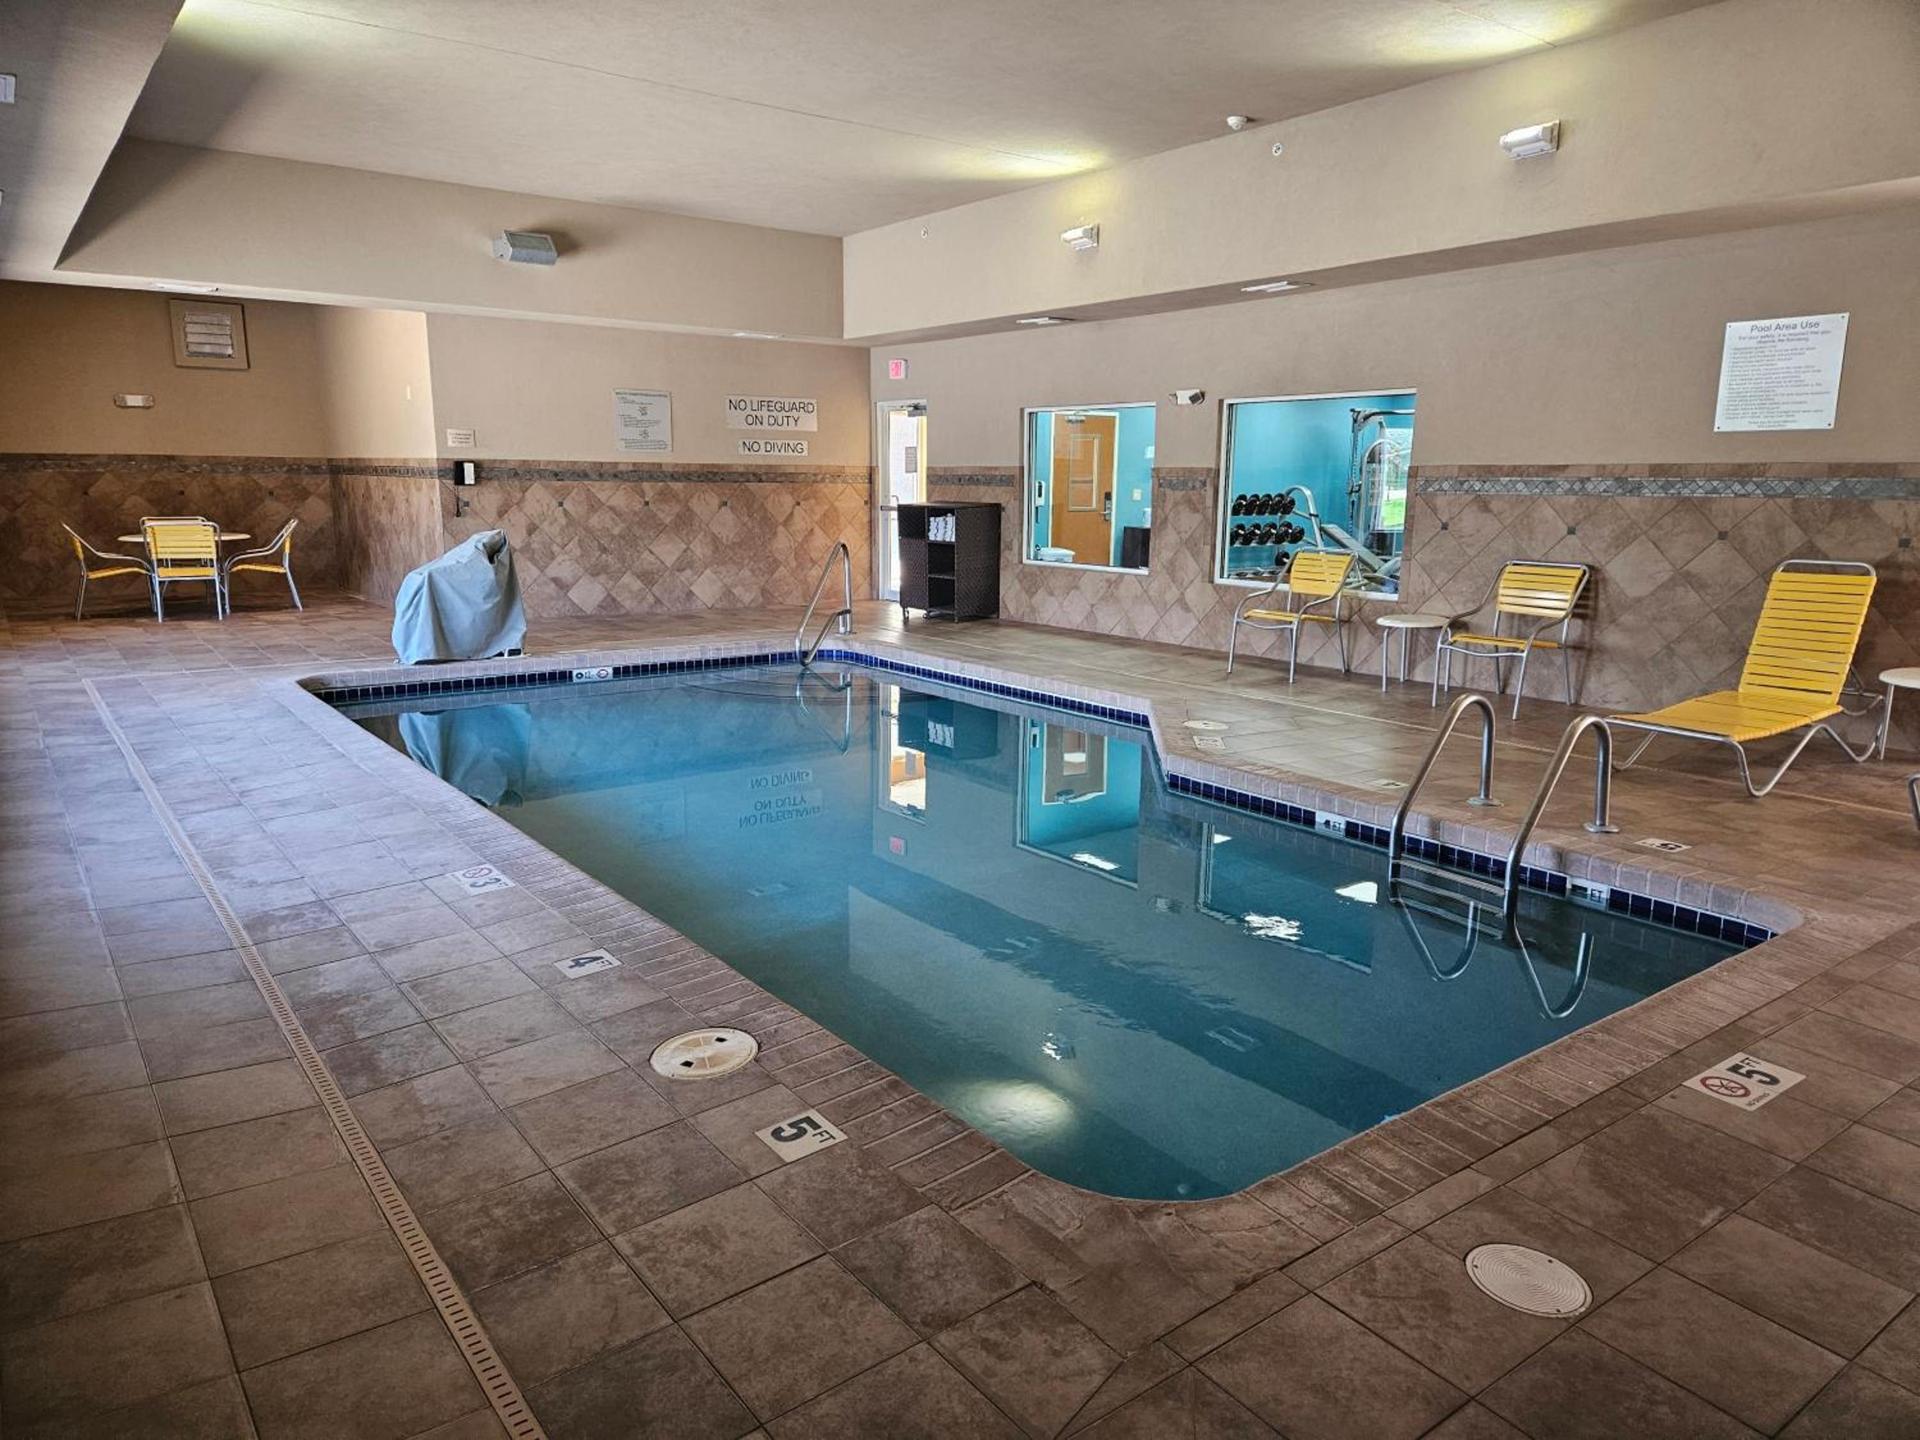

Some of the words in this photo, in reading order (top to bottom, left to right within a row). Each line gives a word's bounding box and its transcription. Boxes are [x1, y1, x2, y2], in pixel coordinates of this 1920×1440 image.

[1750, 324, 1772, 333] Pool
[1774, 322, 1797, 331] Area
[1800, 320, 1820, 329] Use
[728, 399, 747, 412] NO
[750, 400, 815, 414] LIFEGUARD
[745, 414, 763, 426] ON
[767, 414, 800, 427] DUTY
[742, 441, 761, 453] NO
[764, 441, 804, 454] DIVING
[469, 877, 502, 888] 3
[568, 956, 605, 969] 4
[1726, 1063, 1781, 1086] 5
[771, 1116, 822, 1143] 5
[811, 1129, 836, 1143] FT
